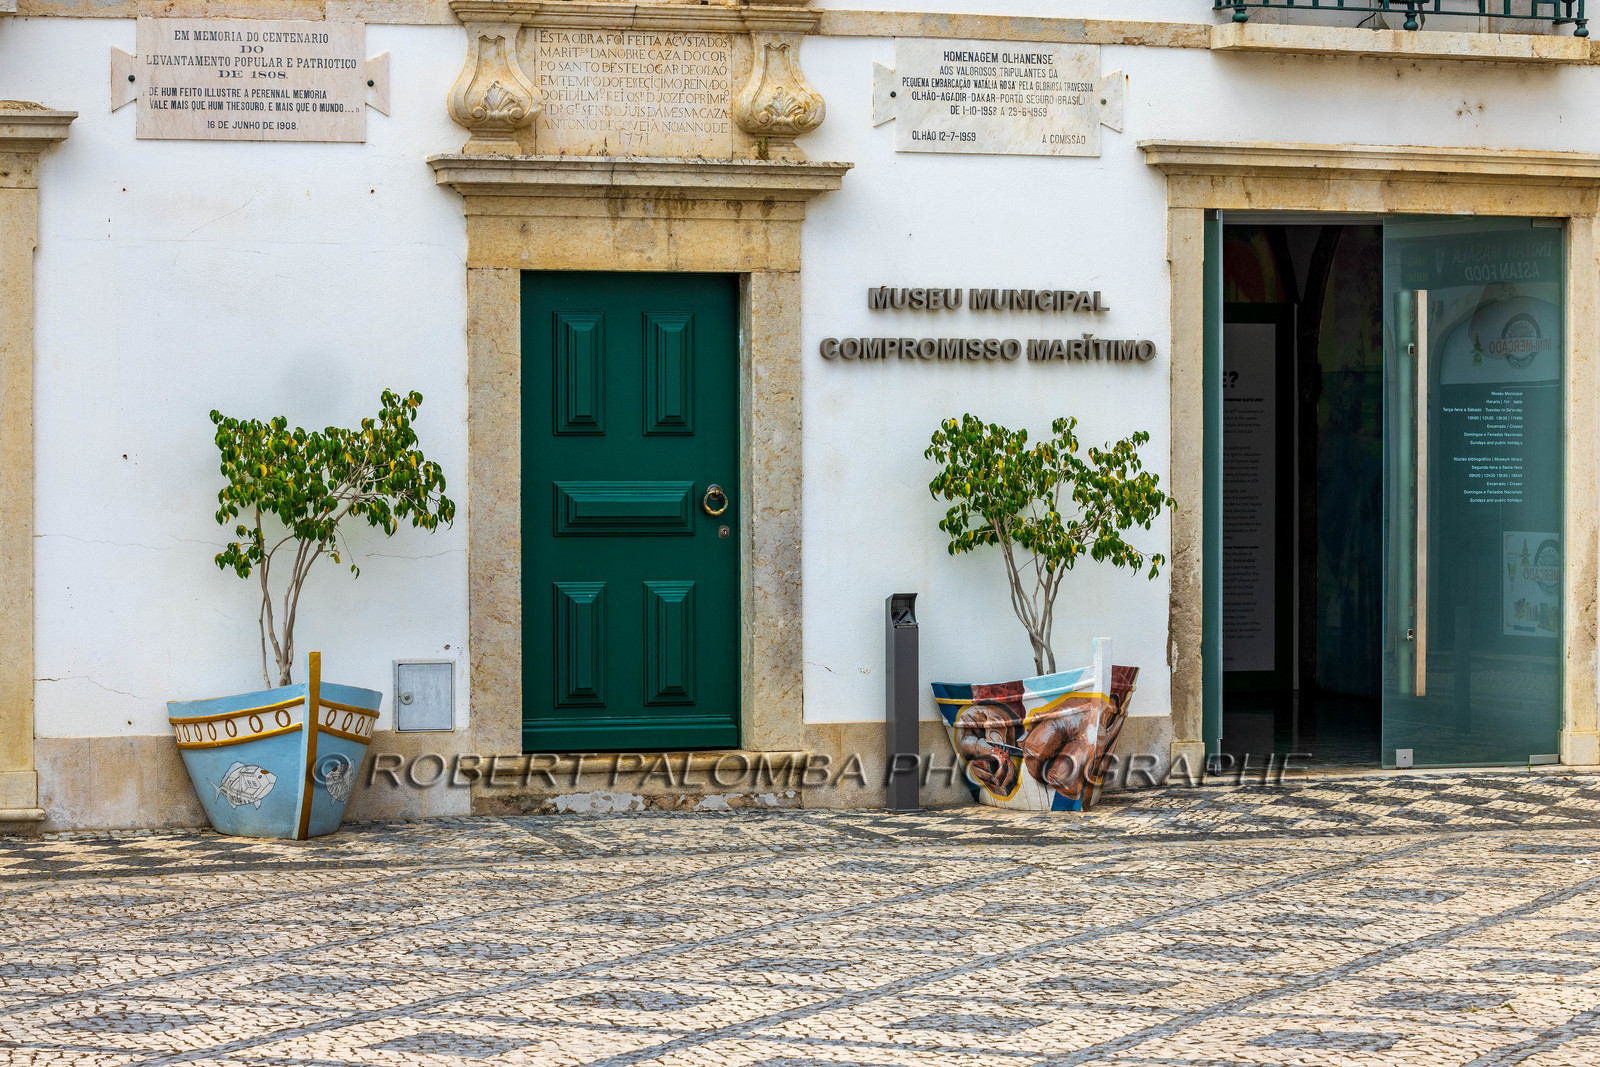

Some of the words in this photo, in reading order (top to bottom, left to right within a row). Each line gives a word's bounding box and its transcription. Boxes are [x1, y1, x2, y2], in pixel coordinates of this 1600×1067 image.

[174, 30, 190, 40] EM
[194, 30, 242, 42] MEMORIA
[246, 32, 259, 42] DO
[263, 32, 328, 44] CENTENARIO
[240, 45, 264, 54] DO
[146, 54, 230, 66] LEVANTAMENTO
[234, 56, 282, 68] POPULAR
[287, 58, 293, 68] E
[296, 58, 356, 69] PATRIOTICO
[944, 51, 998, 63] HOMENAGEM
[1002, 53, 1054, 64] OLHANENSE
[558, 62, 600, 73] SANTO
[940, 66, 954, 76] AOS
[956, 66, 996, 76] VALOROSOS
[1000, 68, 1046, 78] TRIPULANTES
[1049, 70, 1058, 78] DA
[218, 70, 243, 78] DE
[251, 70, 288, 79] 1808.
[902, 77, 930, 88] PEQUENA
[932, 78, 970, 90] EMBARCAÇÃO
[1018, 81, 1034, 90] PELA
[1036, 82, 1062, 92] GLORIOSA
[162, 88, 178, 96] HUM
[180, 88, 202, 97] FEITO
[205, 88, 241, 98] ILLUSTRE
[244, 89, 249, 98] A
[252, 89, 290, 98] PERENNAL
[293, 90, 327, 99] MEMORIA
[1026, 94, 1054, 104] SEGURO
[150, 98, 168, 110] VALE
[171, 100, 188, 110] MAIS
[192, 100, 206, 112] QUE
[208, 101, 223, 110] HUM
[269, 102, 273, 112] E
[276, 102, 294, 112] MAIS
[296, 103, 310, 113] QUE
[312, 103, 317, 112] O
[950, 105, 960, 114] DE
[1000, 107, 1004, 116] A
[208, 120, 215, 129] 16
[218, 121, 228, 129] DE
[232, 122, 260, 130] JUNHO
[263, 122, 274, 130] DE
[277, 122, 298, 130] 1908.
[912, 129, 936, 140] OLHÃO
[938, 132, 976, 142] 12-7-1959
[1042, 134, 1046, 144] A
[1050, 133, 1086, 144] COMISSÃO
[868, 288, 962, 310] MUSEU
[969, 288, 1110, 312] MUNICIPAL
[820, 338, 1021, 361] COMPROMISSO
[1028, 334, 1156, 361] MARÍTIMO
